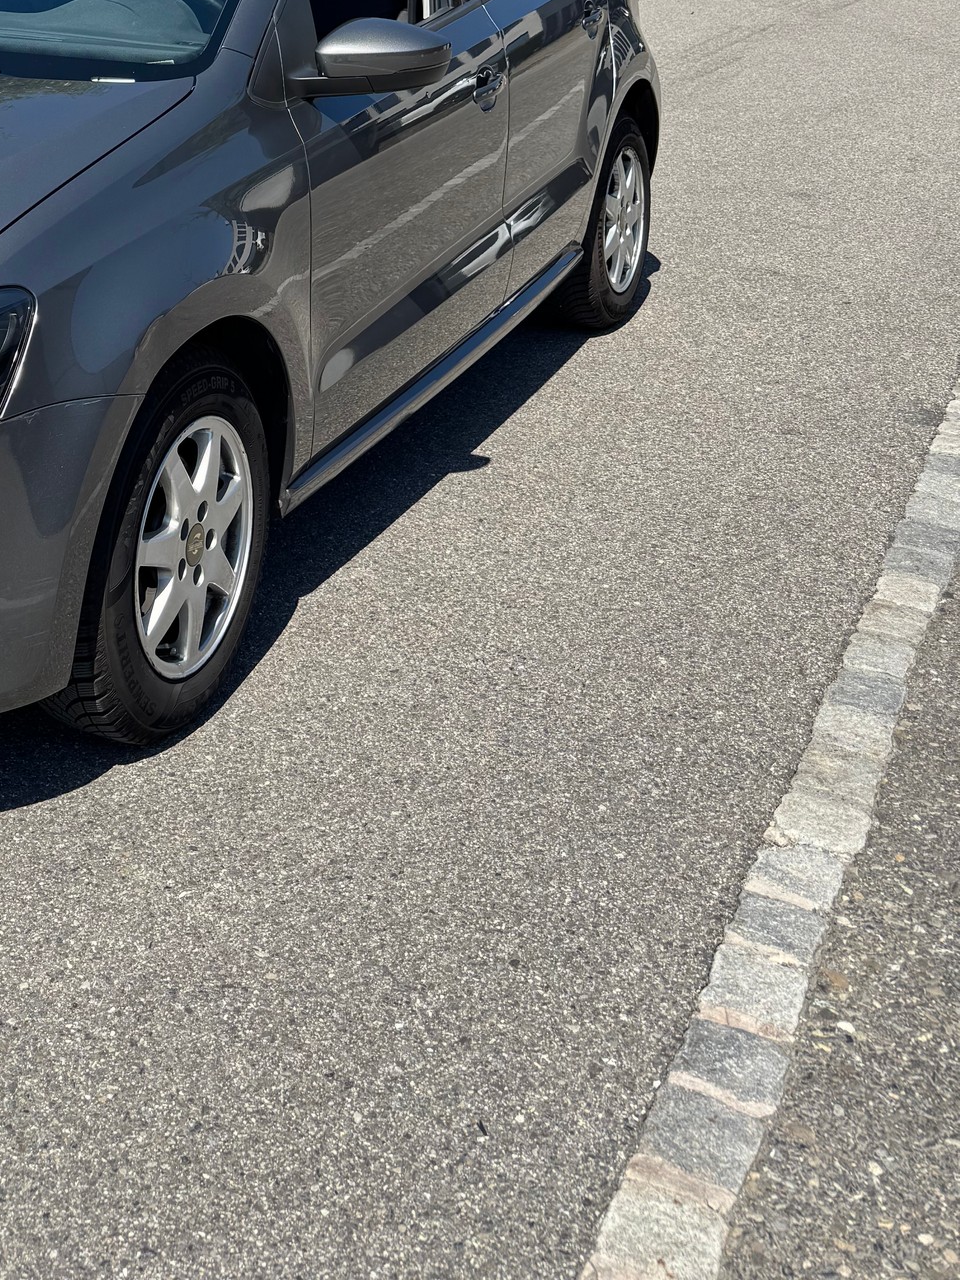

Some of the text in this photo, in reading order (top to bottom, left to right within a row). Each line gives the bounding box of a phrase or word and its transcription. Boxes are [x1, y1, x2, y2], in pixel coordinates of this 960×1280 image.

[180, 376, 236, 406] SPEED-GRIP 5
[115, 631, 157, 716] SEMPERIT
